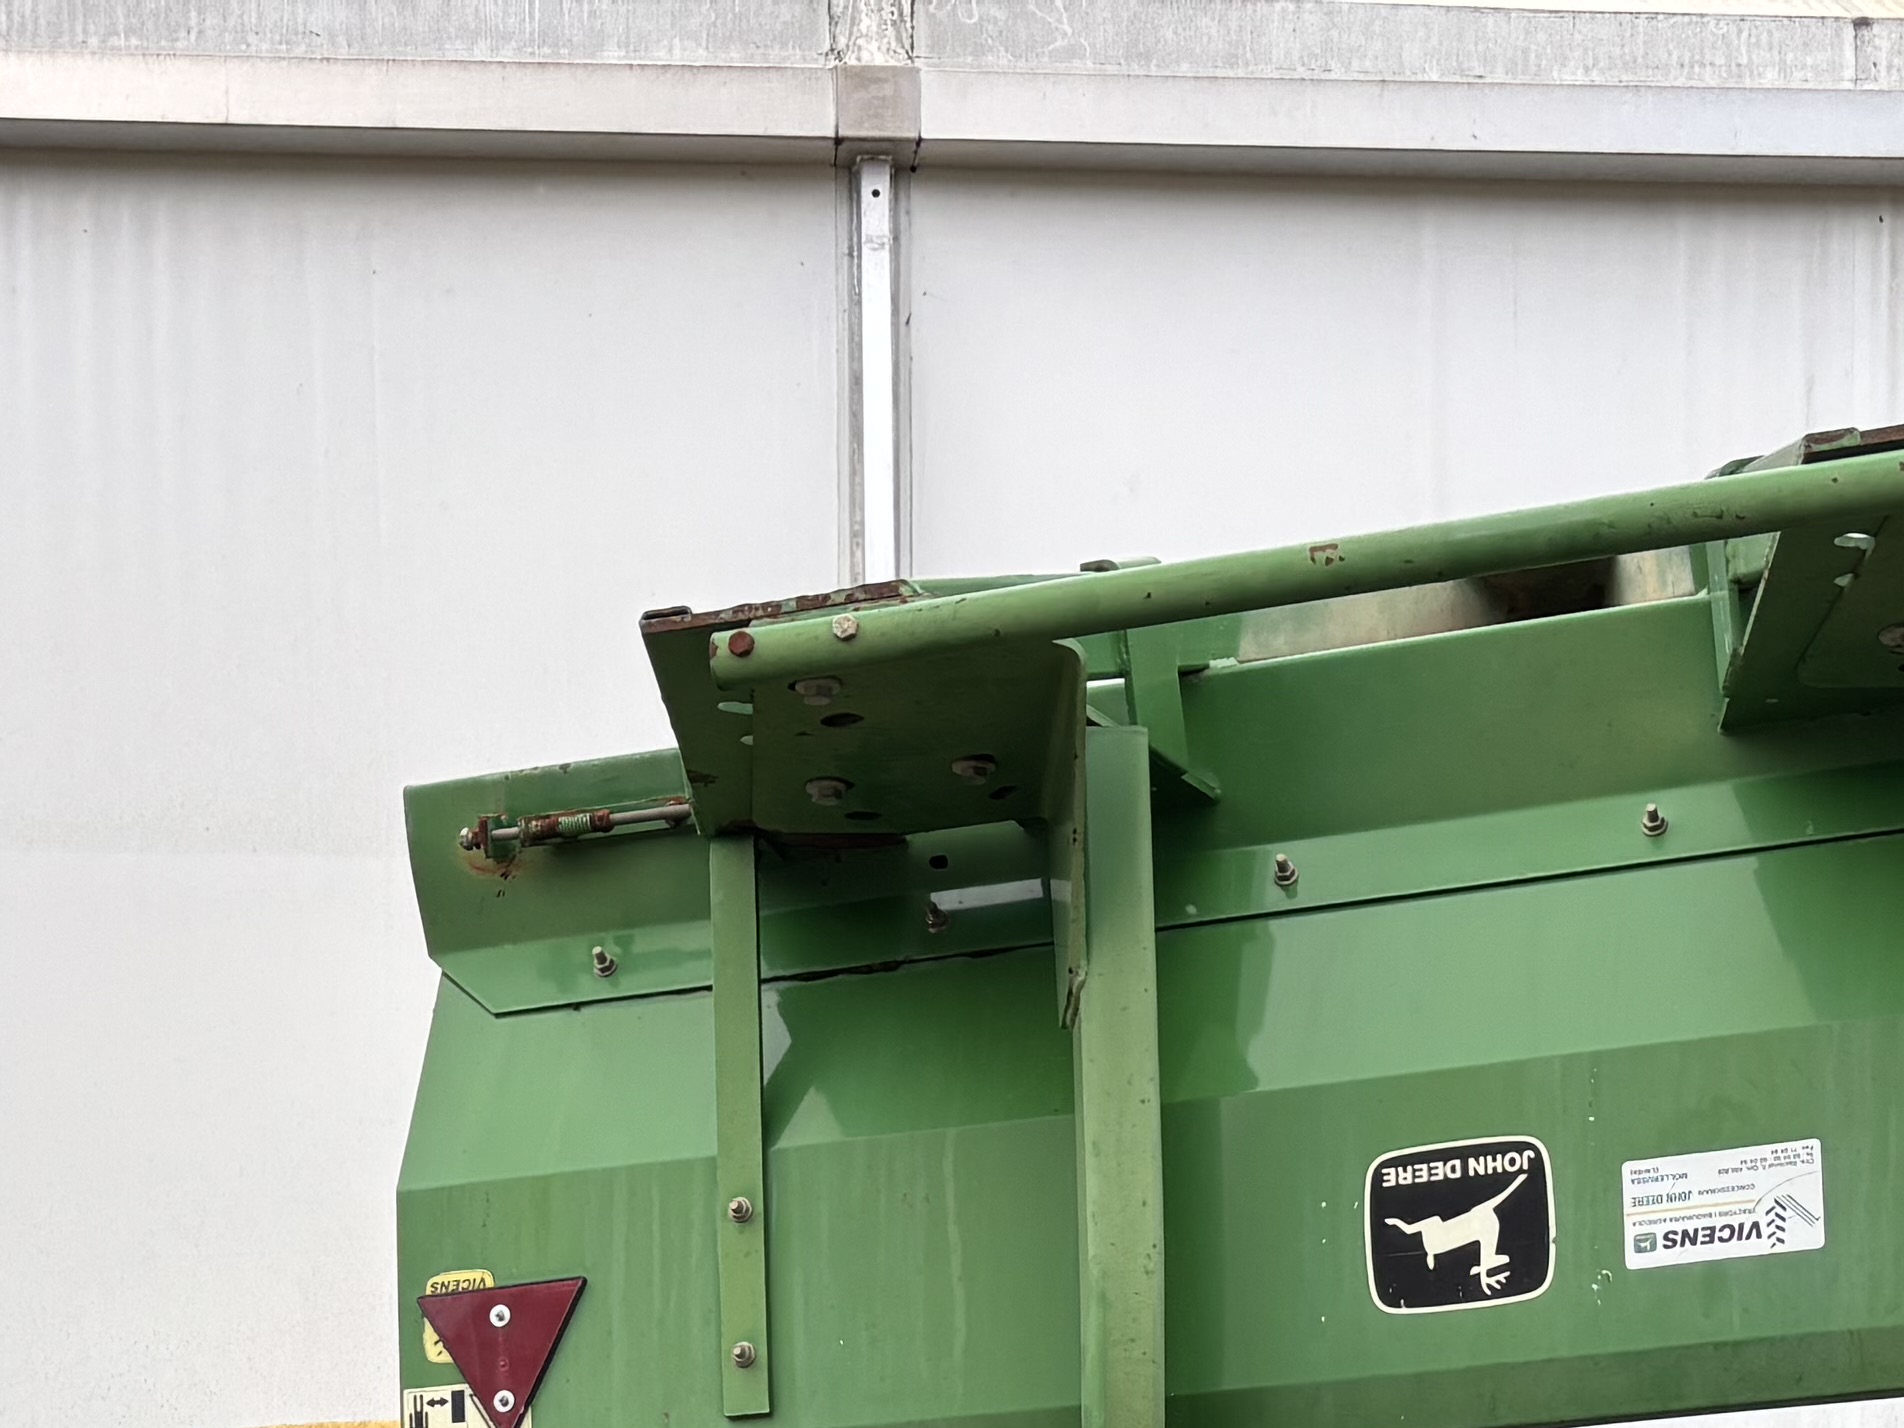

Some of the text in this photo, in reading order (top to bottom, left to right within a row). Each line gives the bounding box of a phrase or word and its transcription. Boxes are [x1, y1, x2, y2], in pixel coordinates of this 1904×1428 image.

[1381, 1150, 1535, 1187] JOHN DEERE
[1662, 1220, 1763, 1250] VICENS
[430, 1276, 486, 1294] VICENS
